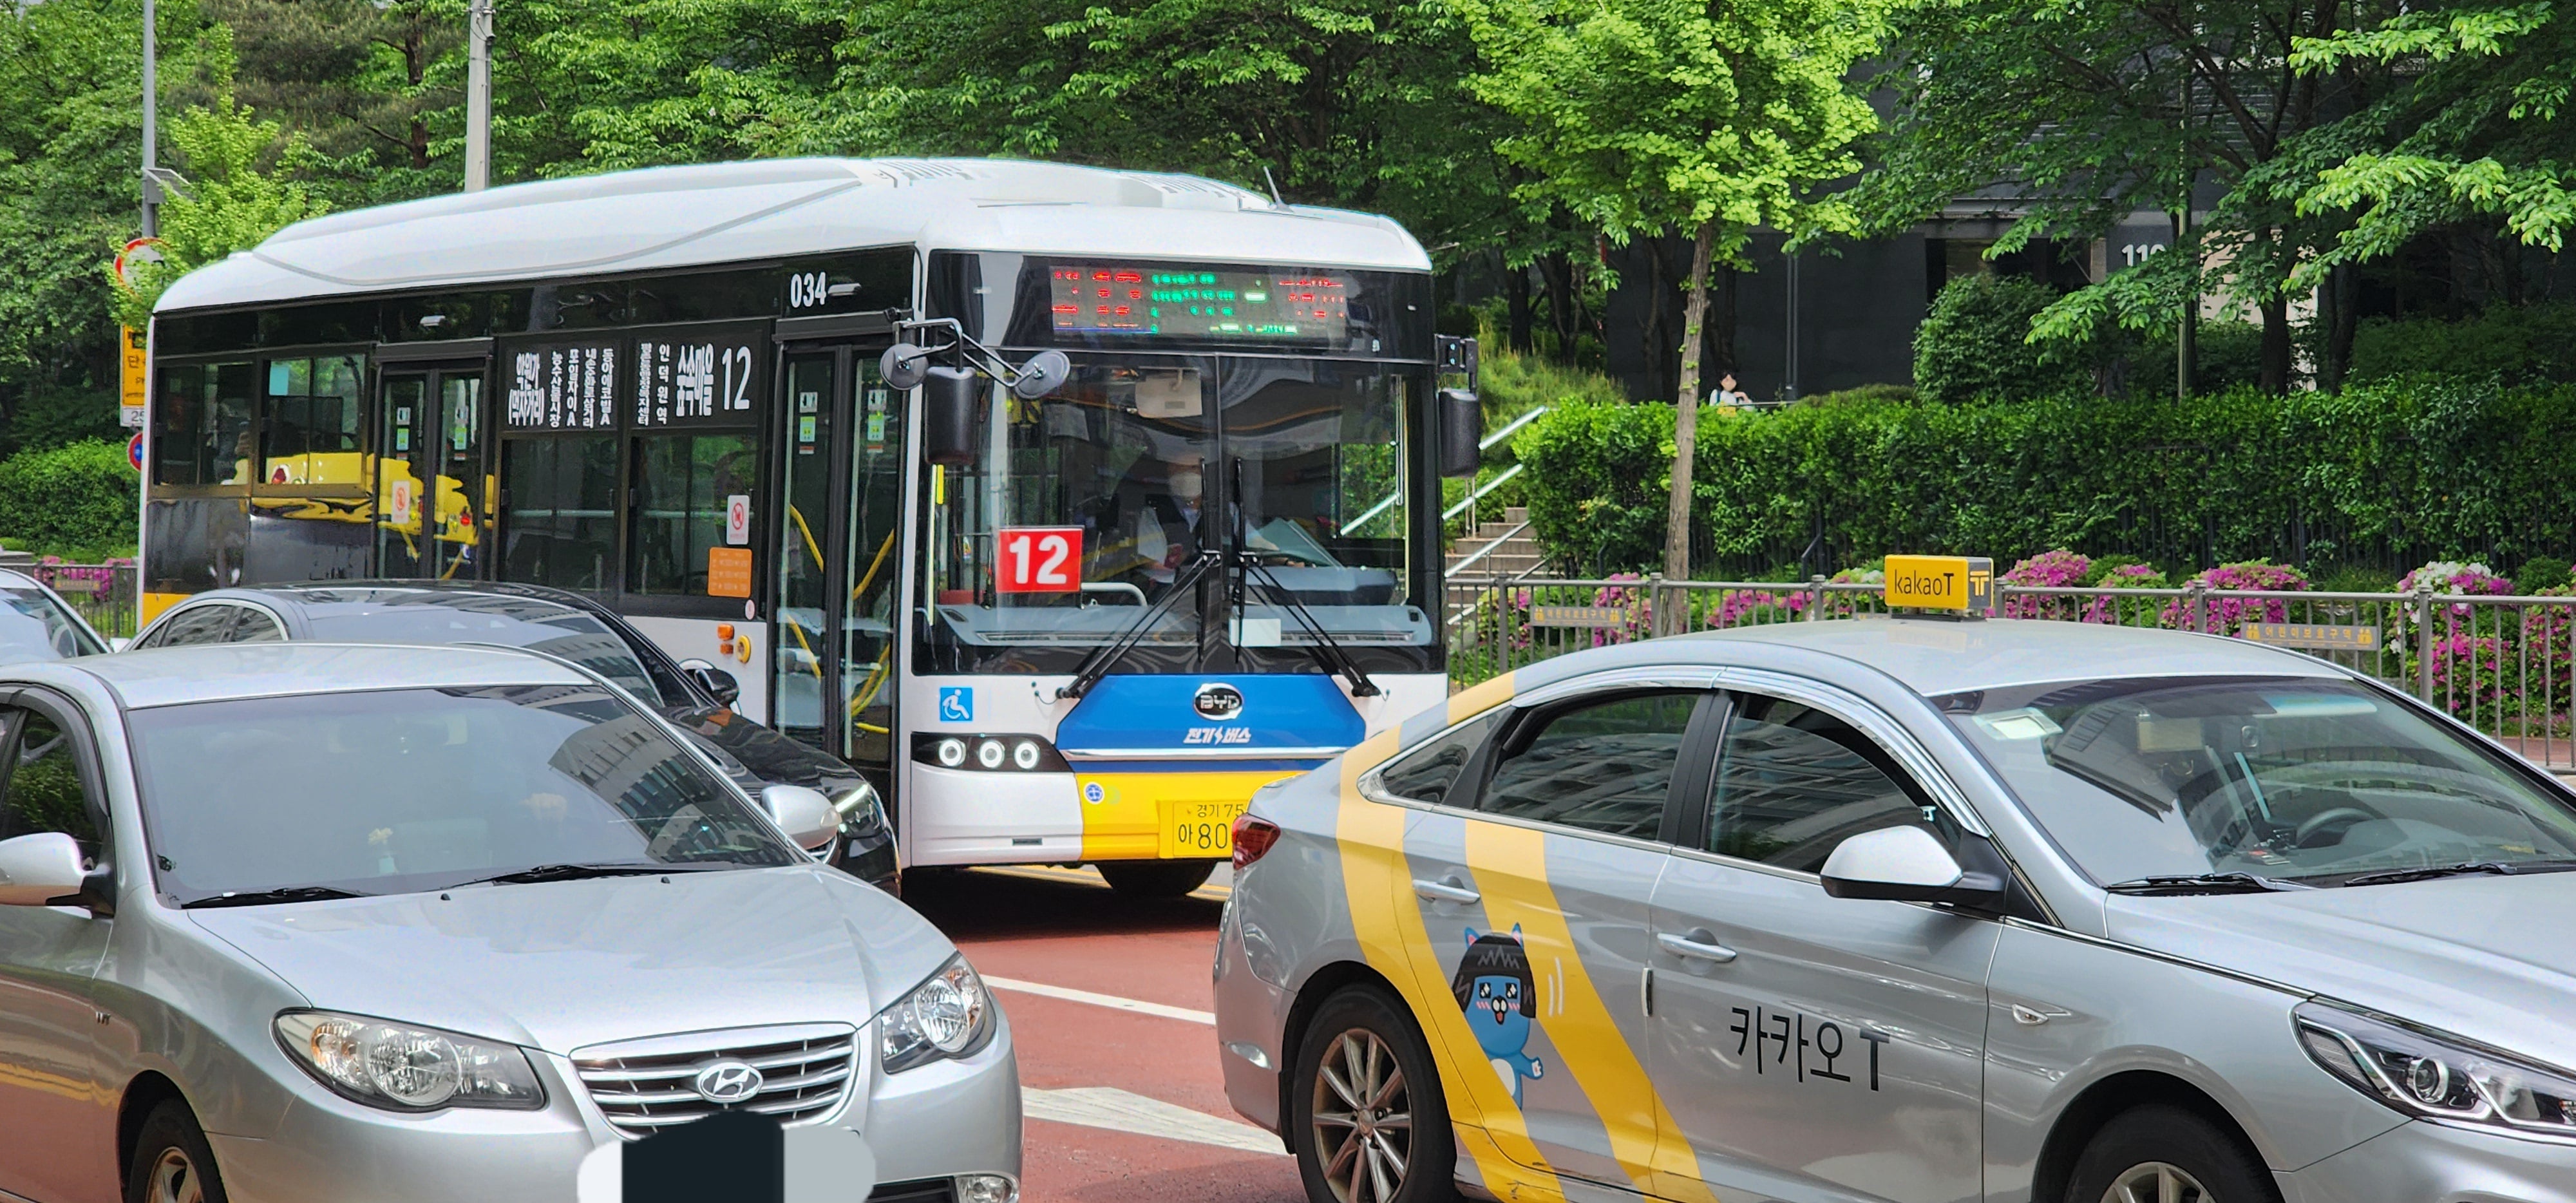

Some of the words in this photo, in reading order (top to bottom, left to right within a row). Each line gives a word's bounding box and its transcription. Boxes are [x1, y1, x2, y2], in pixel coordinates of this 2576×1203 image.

[790, 272, 827, 308] 034
[516, 352, 540, 390] 학원가
[549, 350, 564, 428] 농수산물시장
[600, 348, 614, 426] 동아에코빌A
[656, 343, 670, 425] 인덕원역
[676, 343, 714, 417] 숲속마을
[722, 346, 752, 410] 12
[1009, 535, 1069, 584] 12
[1200, 694, 1240, 709] BYD
